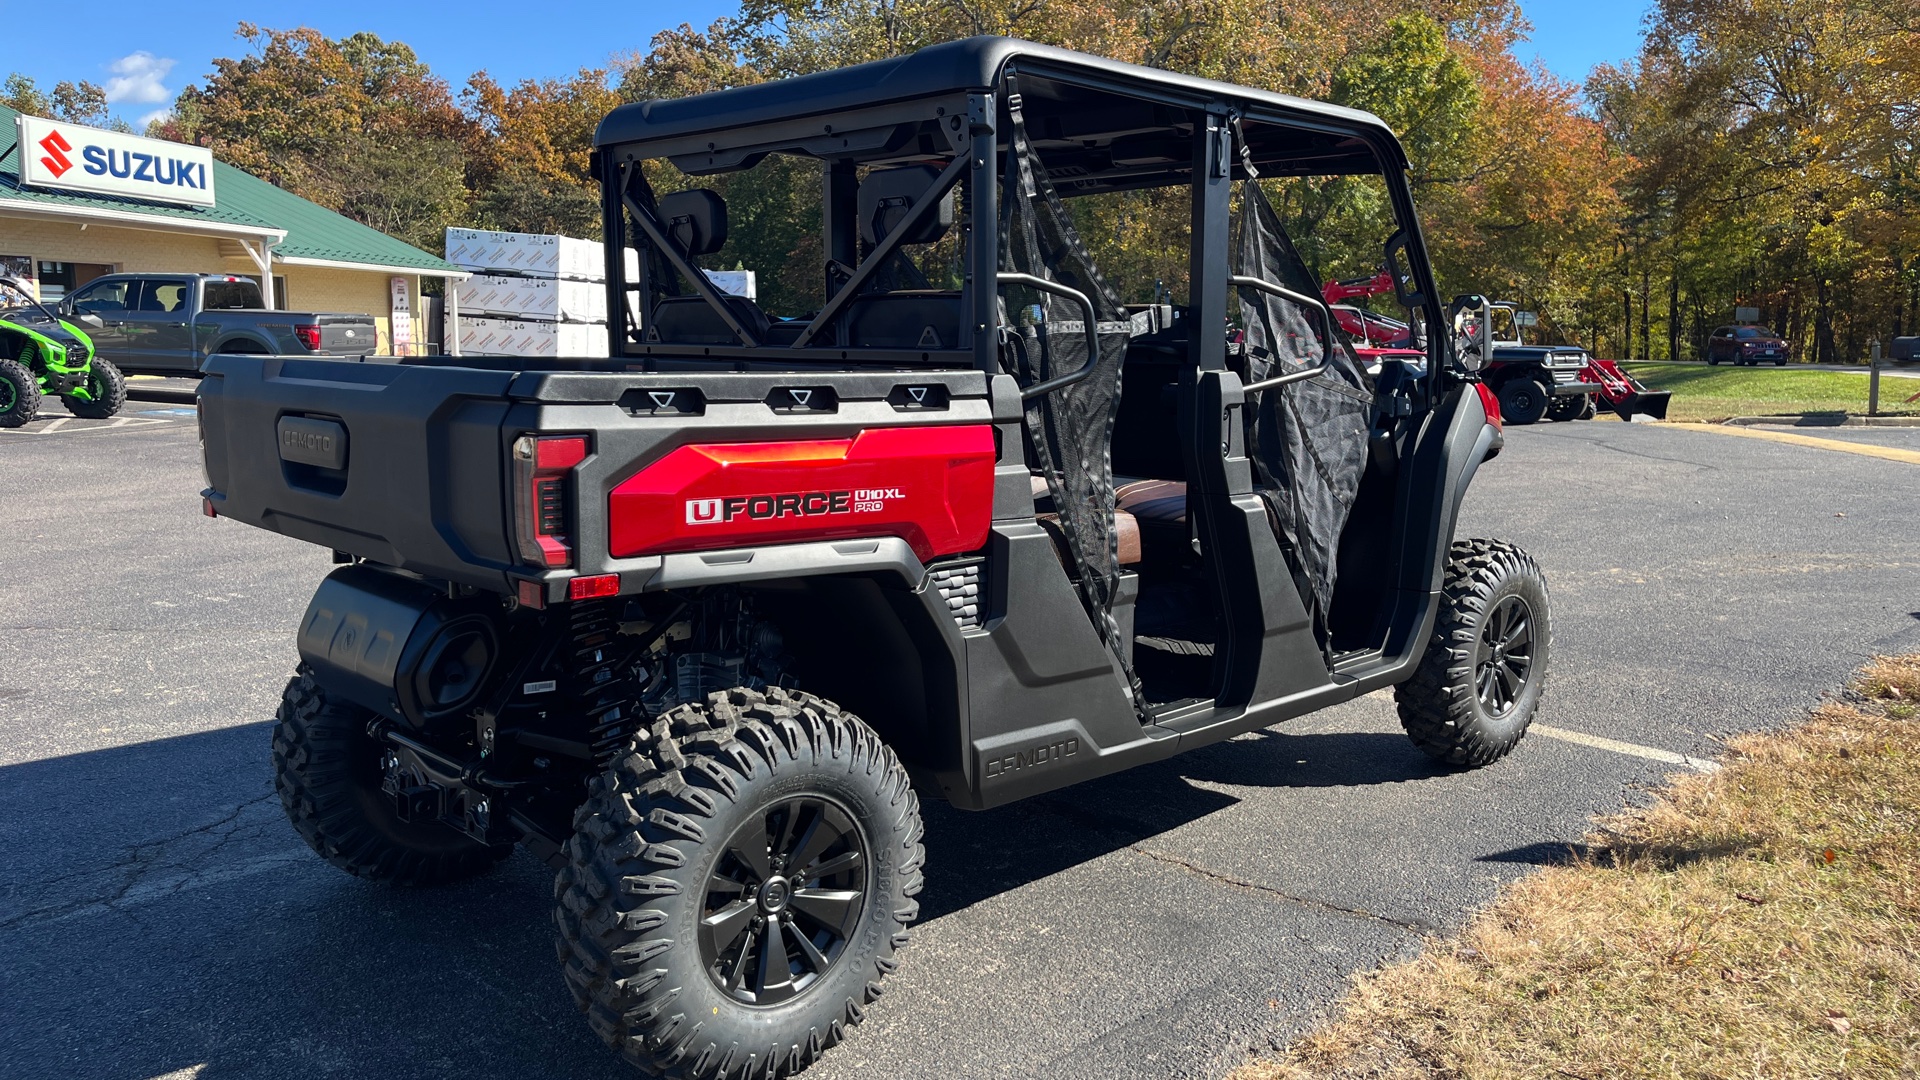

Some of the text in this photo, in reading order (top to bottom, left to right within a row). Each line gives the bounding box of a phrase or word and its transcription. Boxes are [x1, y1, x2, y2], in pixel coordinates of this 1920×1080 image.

[82, 144, 206, 190] SUZUKI
[283, 430, 331, 452] CFMOTO
[854, 501, 884, 513] PRO
[985, 737, 1079, 778] CFMOTO
